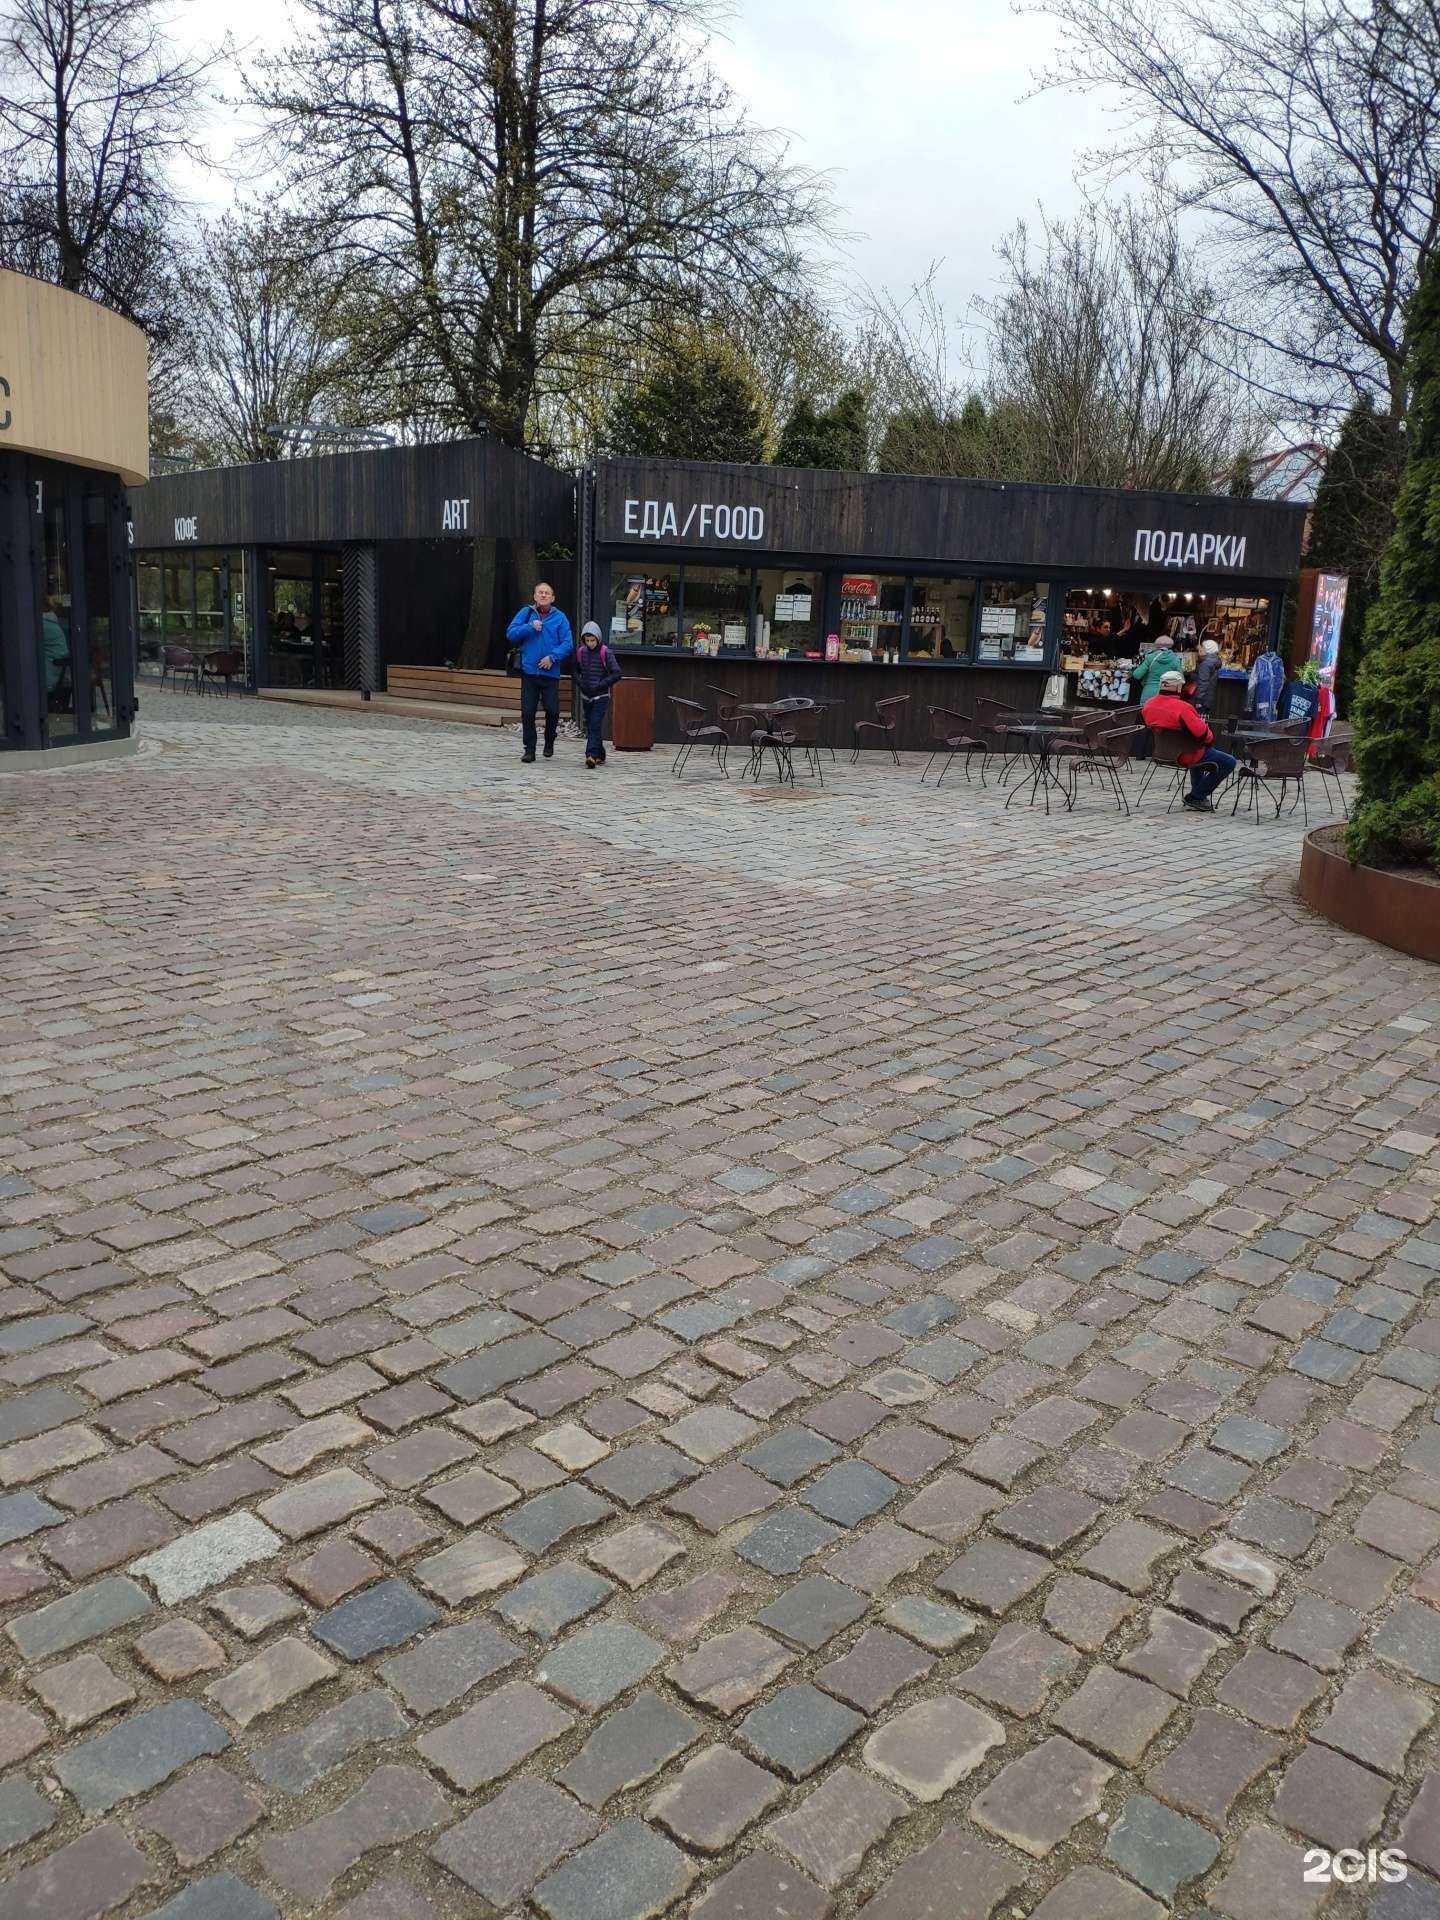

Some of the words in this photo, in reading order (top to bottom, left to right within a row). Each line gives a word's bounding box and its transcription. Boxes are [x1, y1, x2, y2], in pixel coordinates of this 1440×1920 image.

[442, 498, 470, 530] ART
[174, 516, 198, 545] КОФЕ
[1134, 529, 1248, 568] ПОДАРКИ
